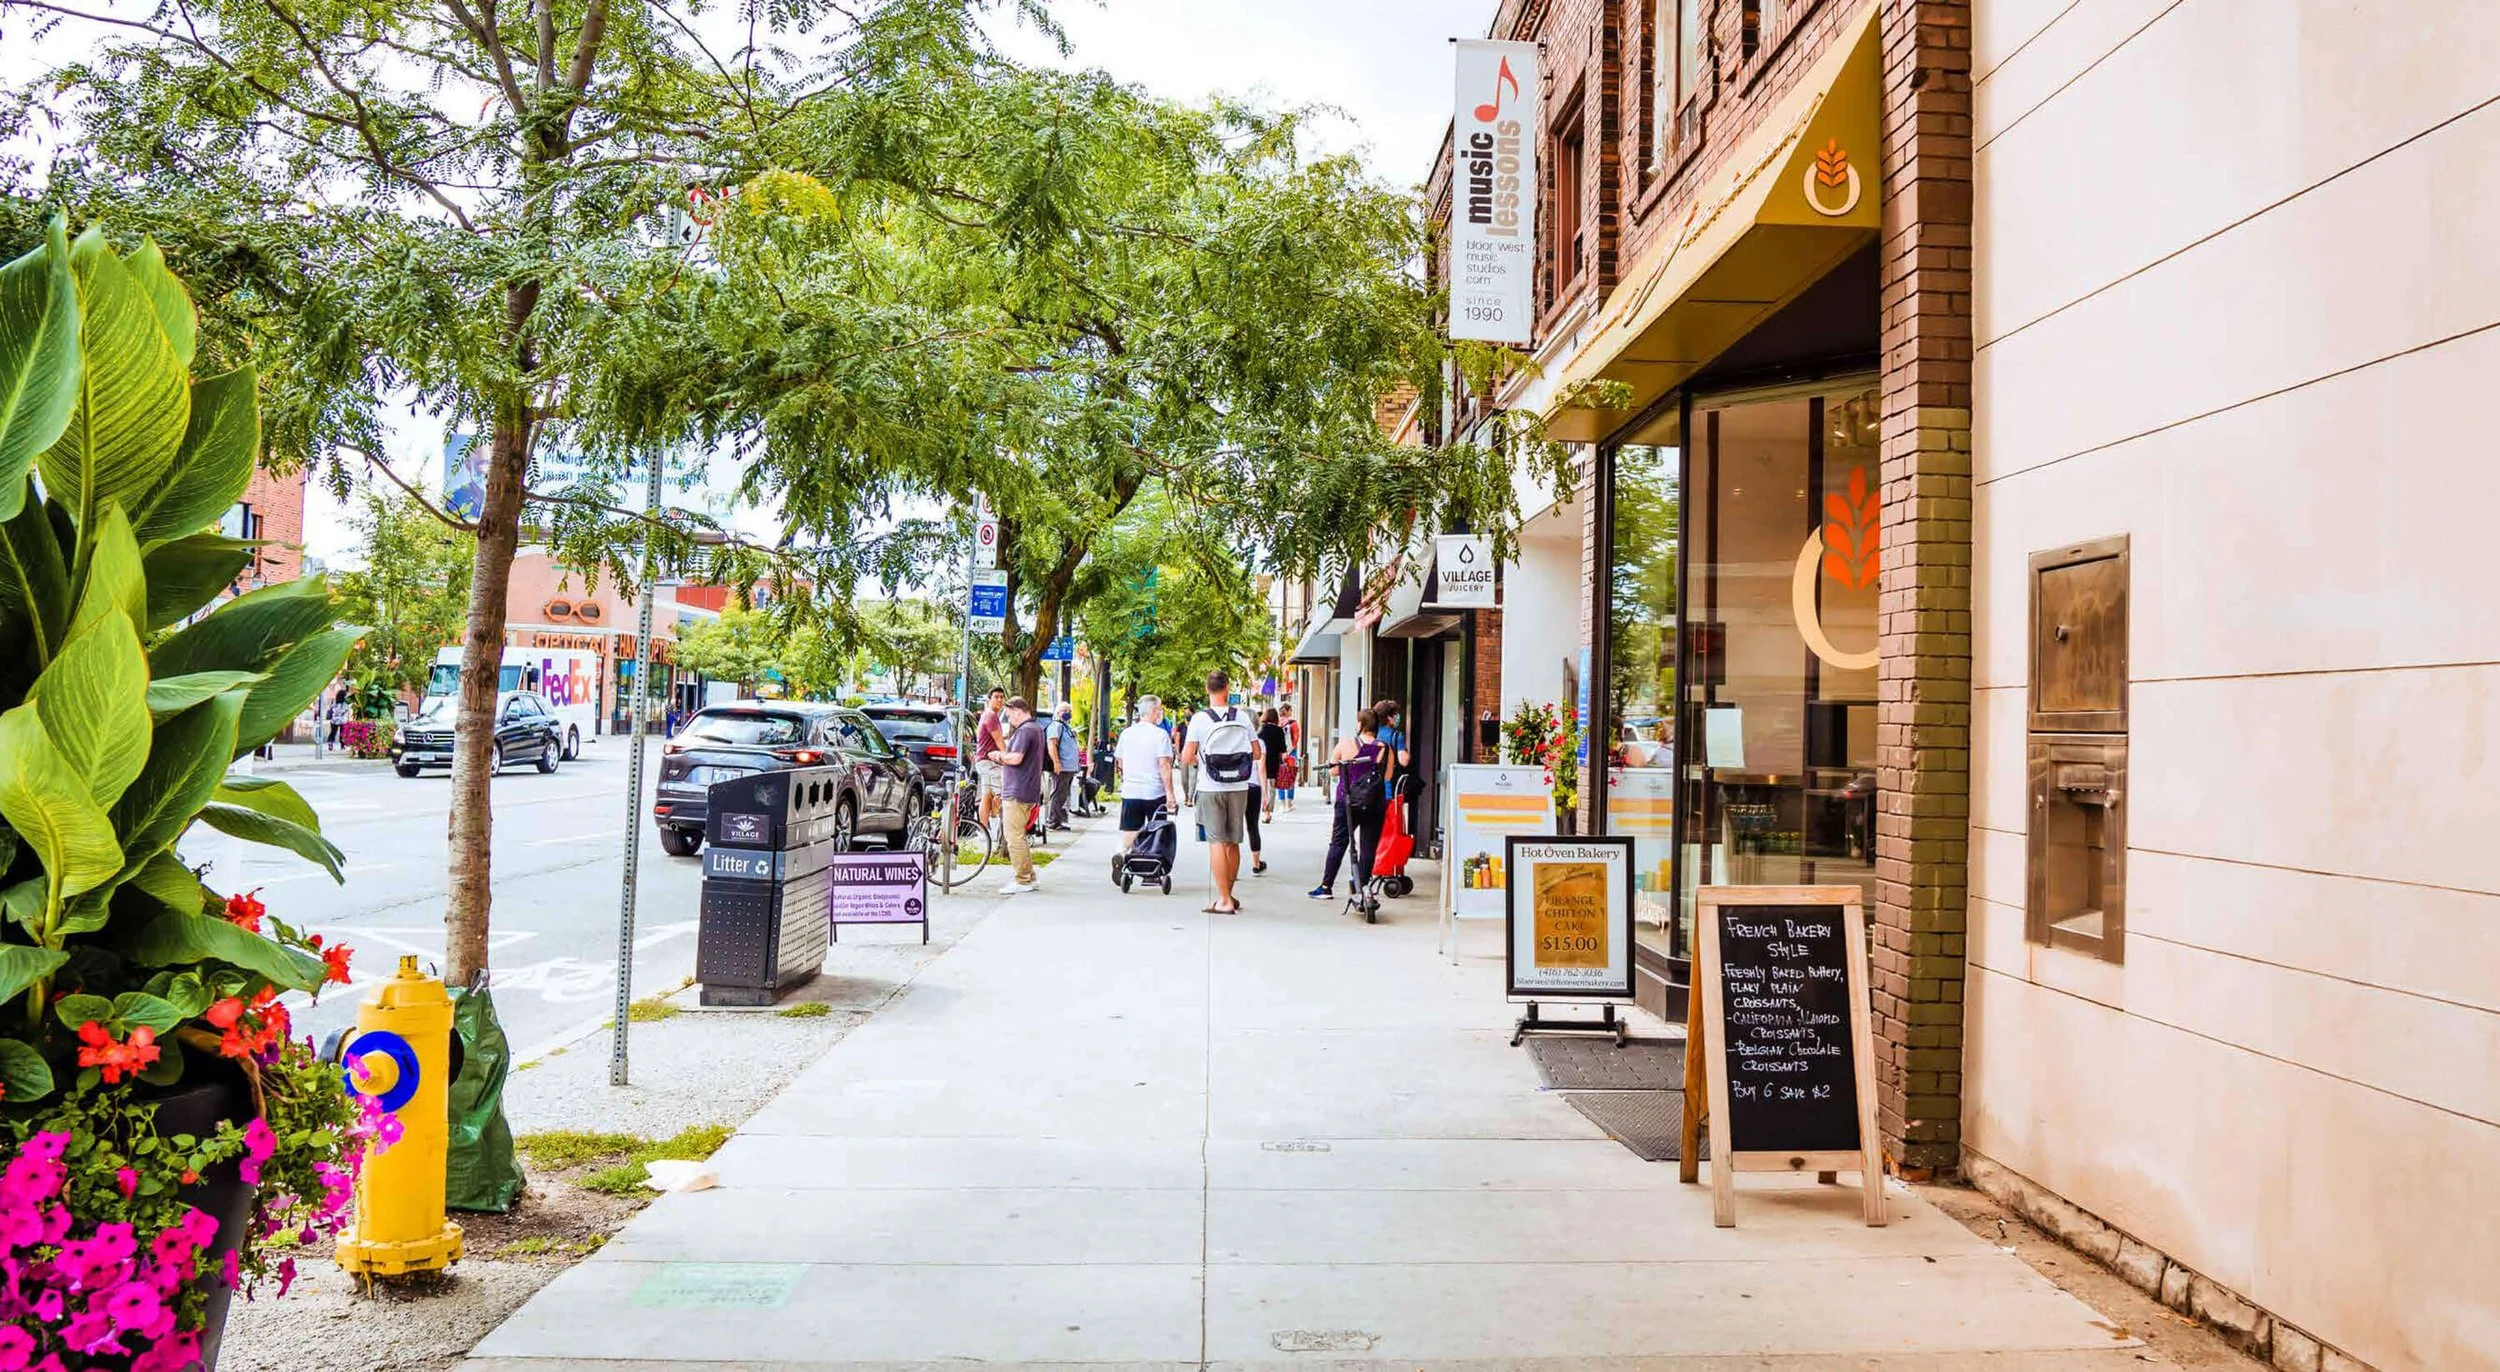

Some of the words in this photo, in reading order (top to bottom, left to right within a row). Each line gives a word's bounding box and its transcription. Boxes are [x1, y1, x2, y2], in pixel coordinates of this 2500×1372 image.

[1461, 132, 1494, 224] music
[1486, 120, 1521, 238] lessons
[1467, 240, 1493, 252] bloor
[1498, 243, 1525, 253] west
[1467, 253, 1498, 262] music
[1466, 262, 1506, 275] studios
[1466, 294, 1501, 306] since
[1465, 306, 1503, 322] 1990
[1442, 570, 1492, 583] VILLAGE
[1449, 584, 1484, 592] JUICERY
[542, 658, 592, 706] FedEx
[1521, 847, 1542, 858] Hot
[1544, 845, 1575, 858] Oven
[1577, 848, 1620, 860] Bakery
[713, 854, 749, 873] Litter
[834, 867, 883, 881] NATURAL
[884, 866, 919, 880] WINES
[1726, 917, 1777, 939] FRENCH
[1785, 919, 1832, 939] BAKERY
[1543, 935, 1598, 951] $15.00
[1772, 966, 1804, 980] BAKED
[1731, 982, 1759, 995] FLAKY
[1741, 1060, 1809, 1072] CROISSANTS
[1763, 1082, 1774, 1098] 6
[1812, 1084, 1830, 1100] $2
